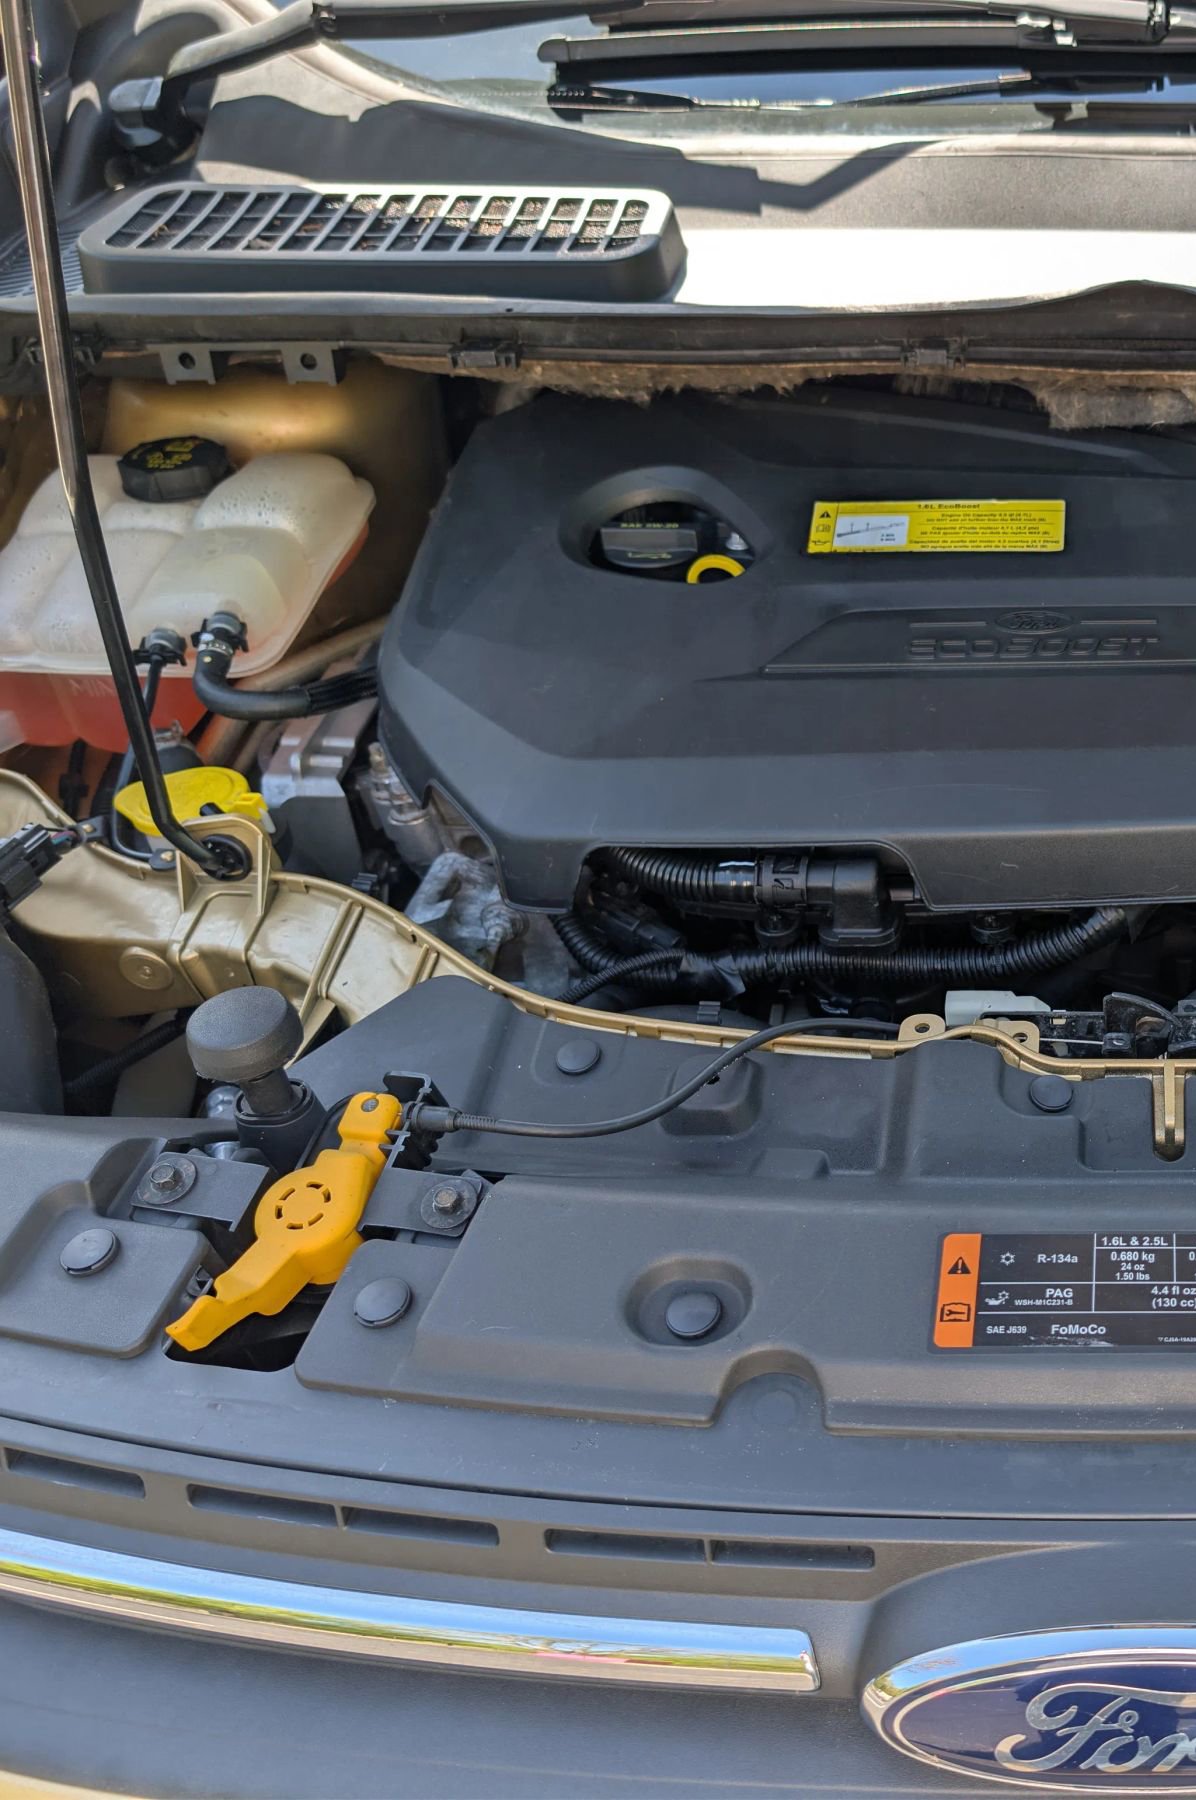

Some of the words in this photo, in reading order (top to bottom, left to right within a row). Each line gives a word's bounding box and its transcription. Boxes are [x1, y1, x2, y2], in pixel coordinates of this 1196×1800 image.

[908, 638, 1160, 660] ECOBOOST
[1101, 1236, 1127, 1246] 1.6L
[1130, 1237, 1140, 1246] &
[1142, 1236, 1169, 1246] 2.5L
[1037, 1253, 1079, 1264] R-134a
[1110, 1251, 1139, 1261] 0.680
[1142, 1251, 1155, 1263] kg
[1120, 1262, 1132, 1271] 24
[1115, 1272, 1134, 1280] 1.50
[1136, 1272, 1150, 1280] lbs
[1045, 1287, 1074, 1299] PAG
[1151, 1285, 1169, 1295] 4.4
[1171, 1285, 1180, 1295] fl
[1183, 1287, 1196, 1295] oz
[1151, 1297, 1177, 1309] (130
[986, 1325, 1004, 1334] SAE
[1006, 1325, 1027, 1334] J639
[1051, 1324, 1107, 1335] FoMoCo
